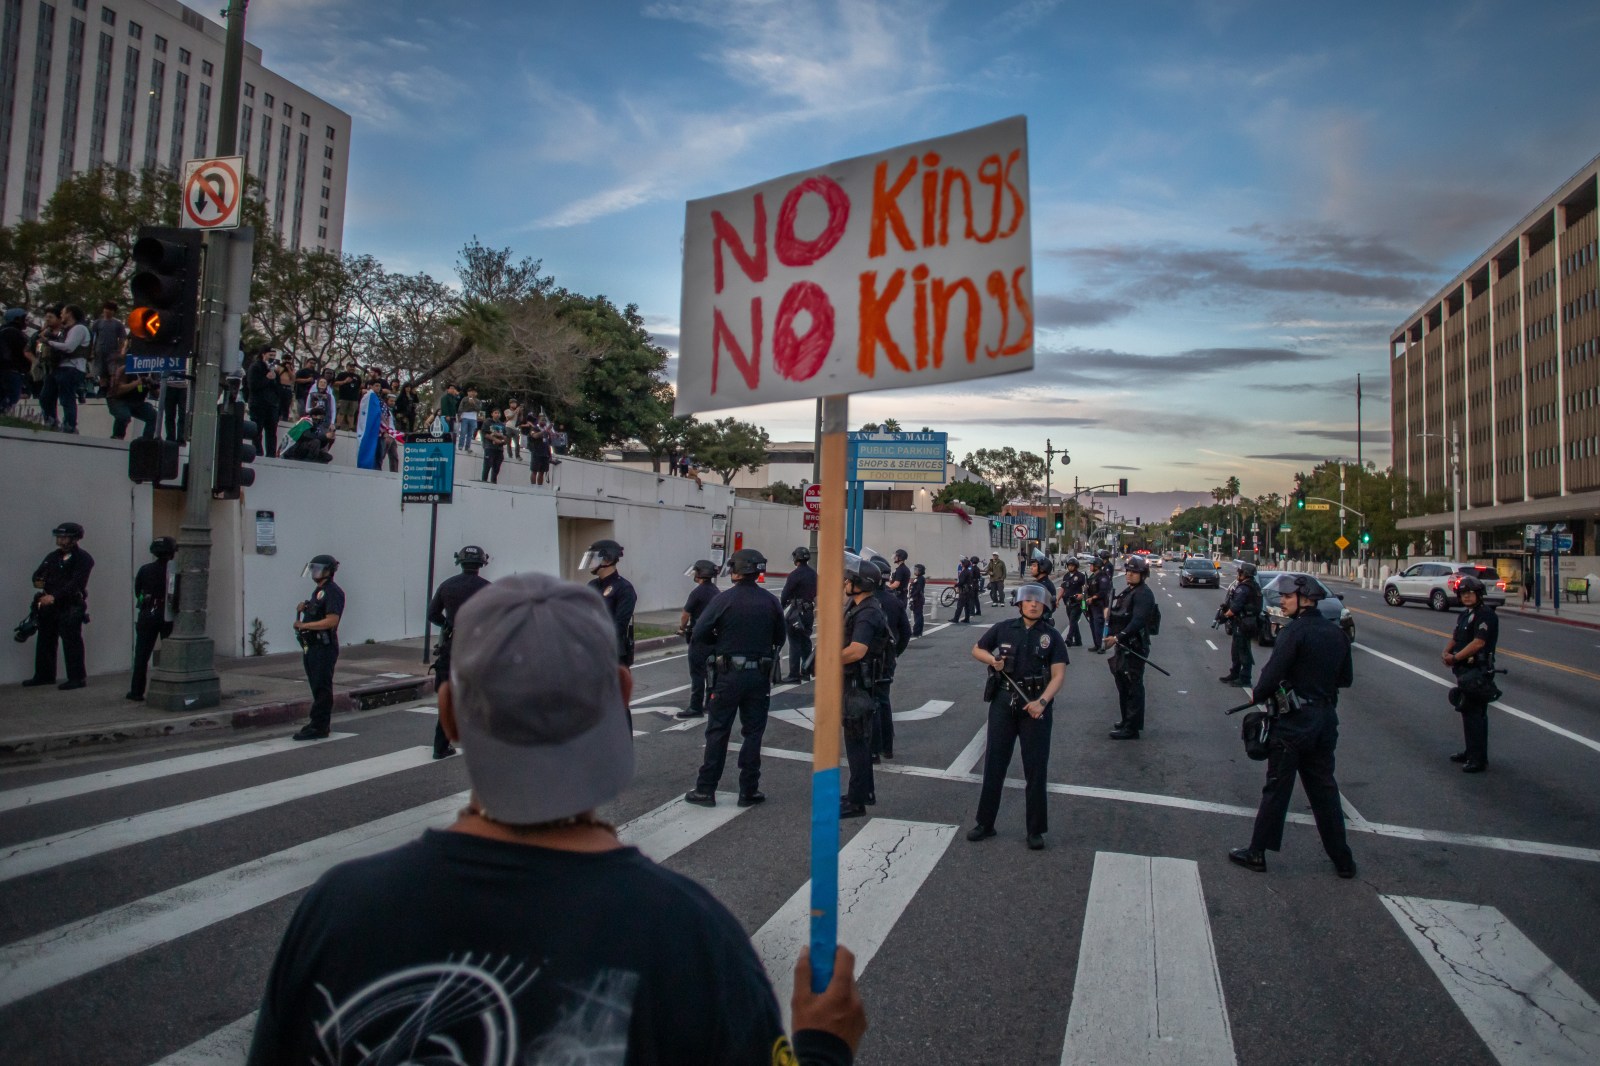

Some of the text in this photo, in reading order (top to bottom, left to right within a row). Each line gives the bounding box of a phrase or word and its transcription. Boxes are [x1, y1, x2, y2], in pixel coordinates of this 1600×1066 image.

[710, 148, 1025, 294] NO Kings
[710, 262, 1034, 396] NO Kings
[133, 356, 180, 371] Temple St
[905, 432, 935, 441] MALL
[860, 445, 940, 456] PUBLIC PARKING
[858, 460, 943, 469] SHOPS & SERVICES
[870, 471, 929, 480] FOOD COURT
